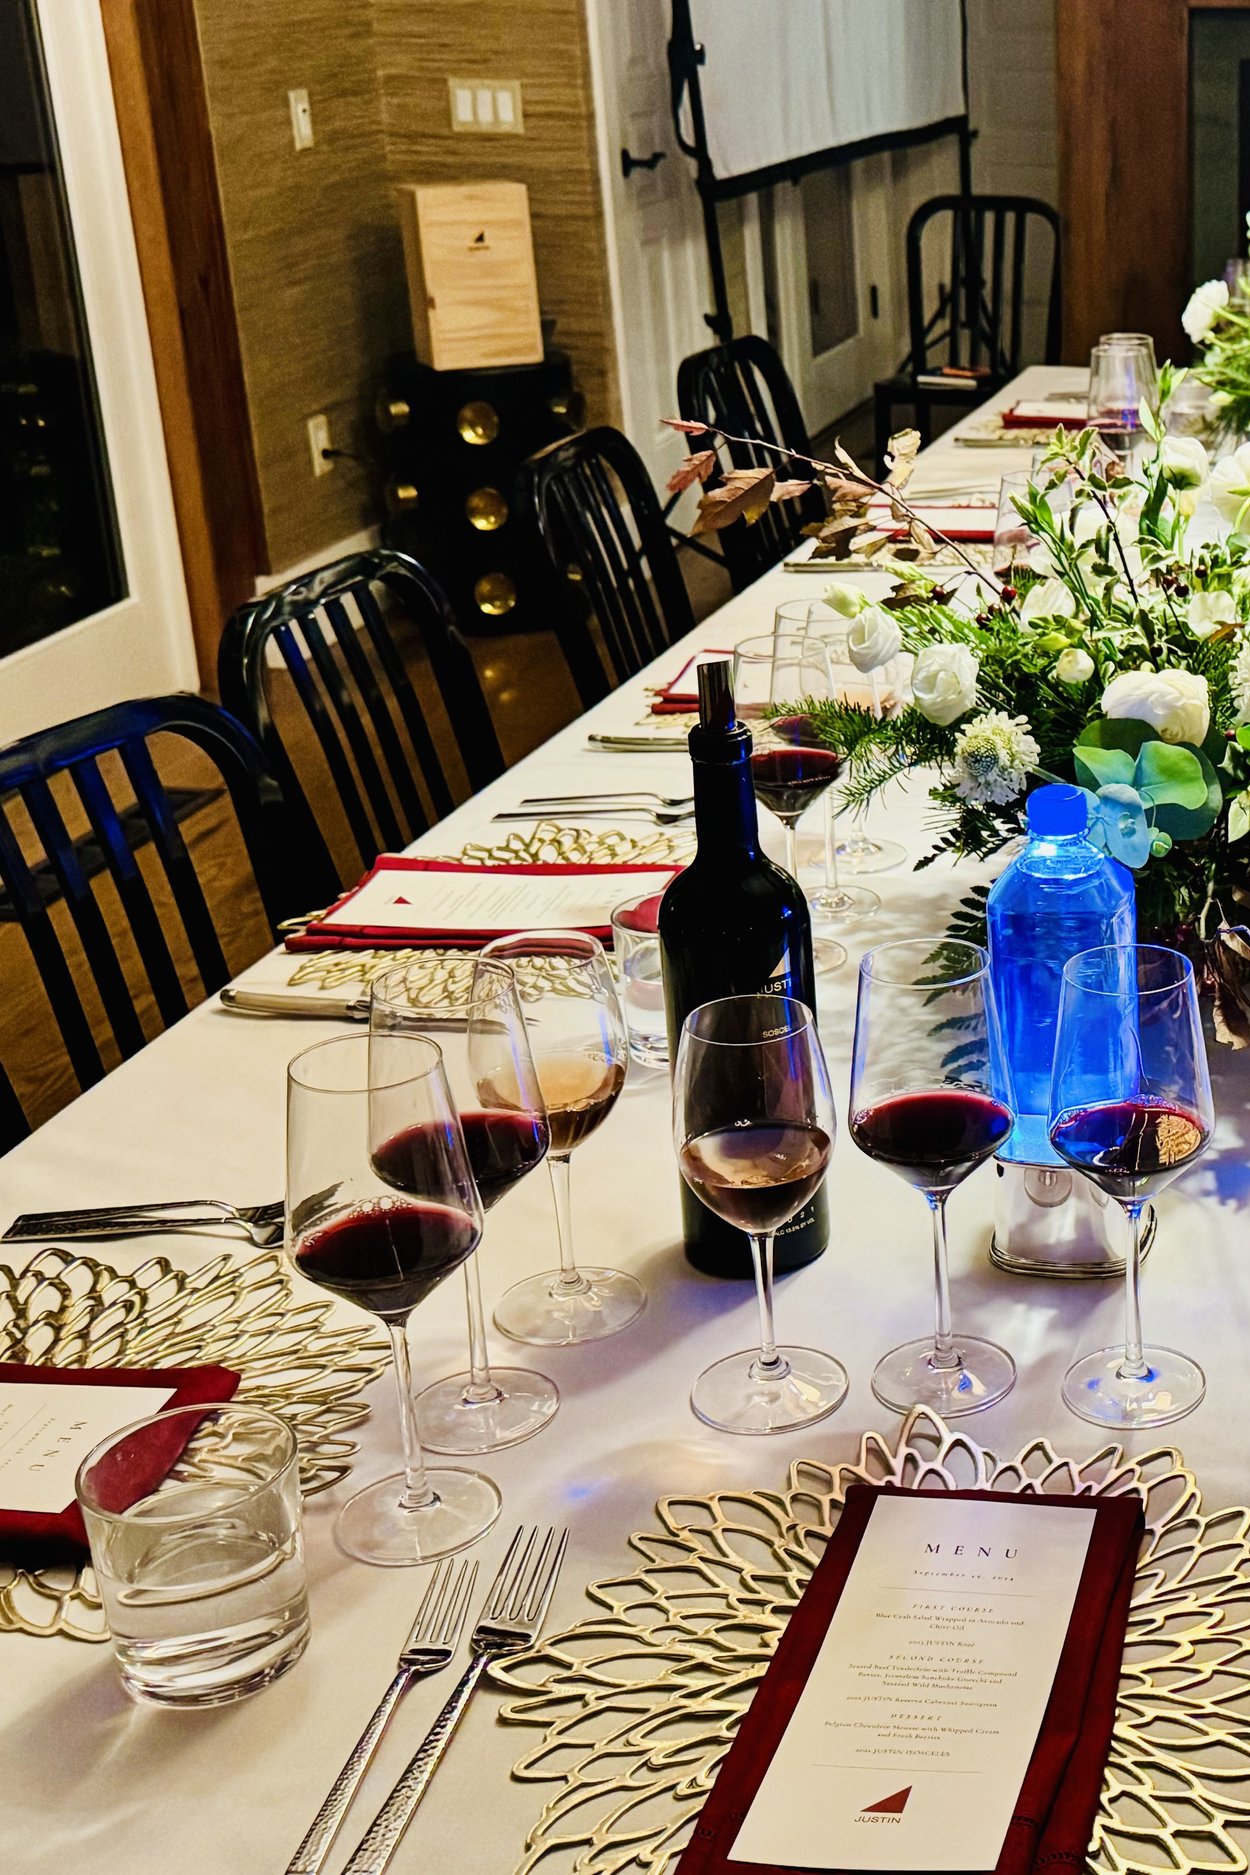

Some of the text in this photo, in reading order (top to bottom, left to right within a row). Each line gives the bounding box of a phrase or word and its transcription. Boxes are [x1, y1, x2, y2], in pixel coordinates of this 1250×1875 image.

[28, 1421, 88, 1472] MENU
[924, 1543, 1019, 1559] MENU
[935, 1615, 967, 1624] Wrapped
[925, 1639, 955, 1647] JUSTIN
[888, 1654, 934, 1662] SECOND
[863, 1695, 893, 1703] JUSTIN
[890, 1713, 944, 1722] DESSERT
[940, 1727, 974, 1735] Whipped
[871, 1747, 903, 1757] JUSTIN
[854, 1816, 901, 1824] JUSTIN
